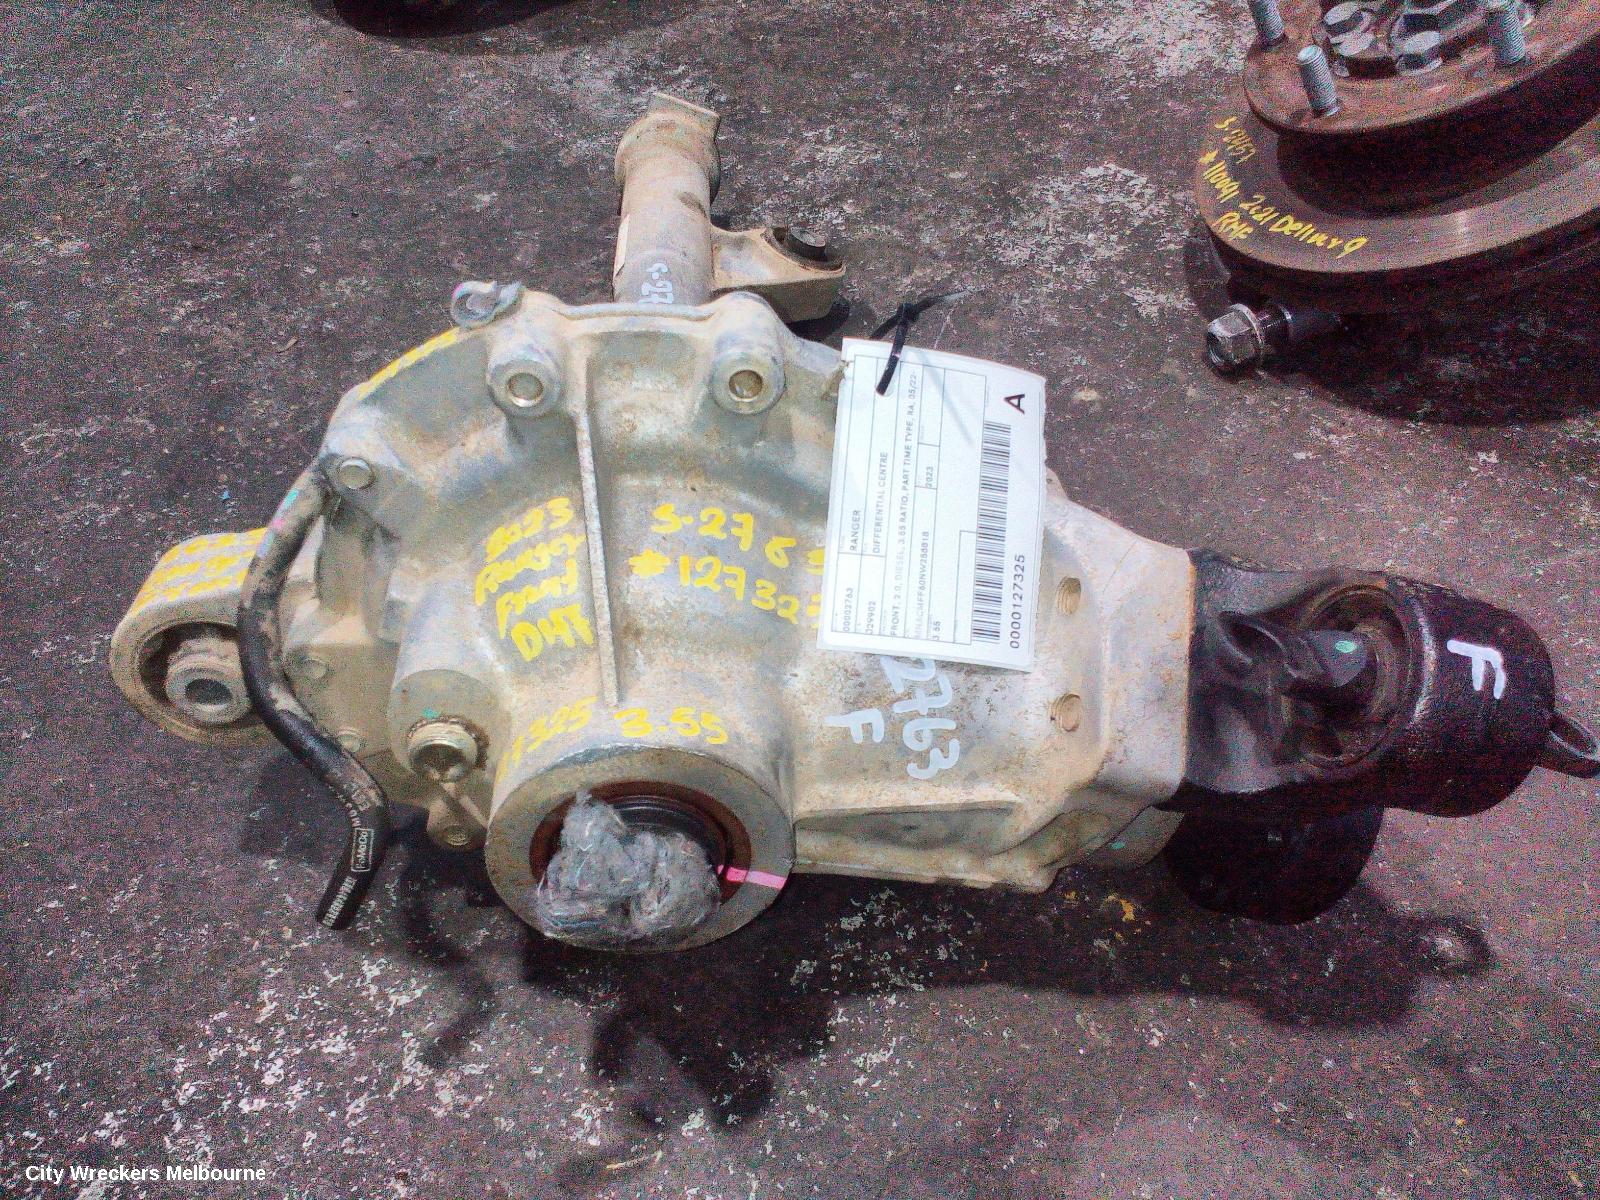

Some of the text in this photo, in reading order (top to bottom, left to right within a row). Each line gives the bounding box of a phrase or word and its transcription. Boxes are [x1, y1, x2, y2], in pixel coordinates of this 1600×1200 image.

[1003, 393, 1026, 415] A
[903, 445, 912, 466] TIME
[900, 469, 910, 491] PART
[925, 466, 934, 488] 2023
[872, 452, 888, 553] DIFFERENTIAL CENTRE
[849, 510, 861, 551] RANGER
[1010, 554, 1025, 649] 0000127325
[1446, 639, 1507, 699] F
[824, 708, 885, 744] F
